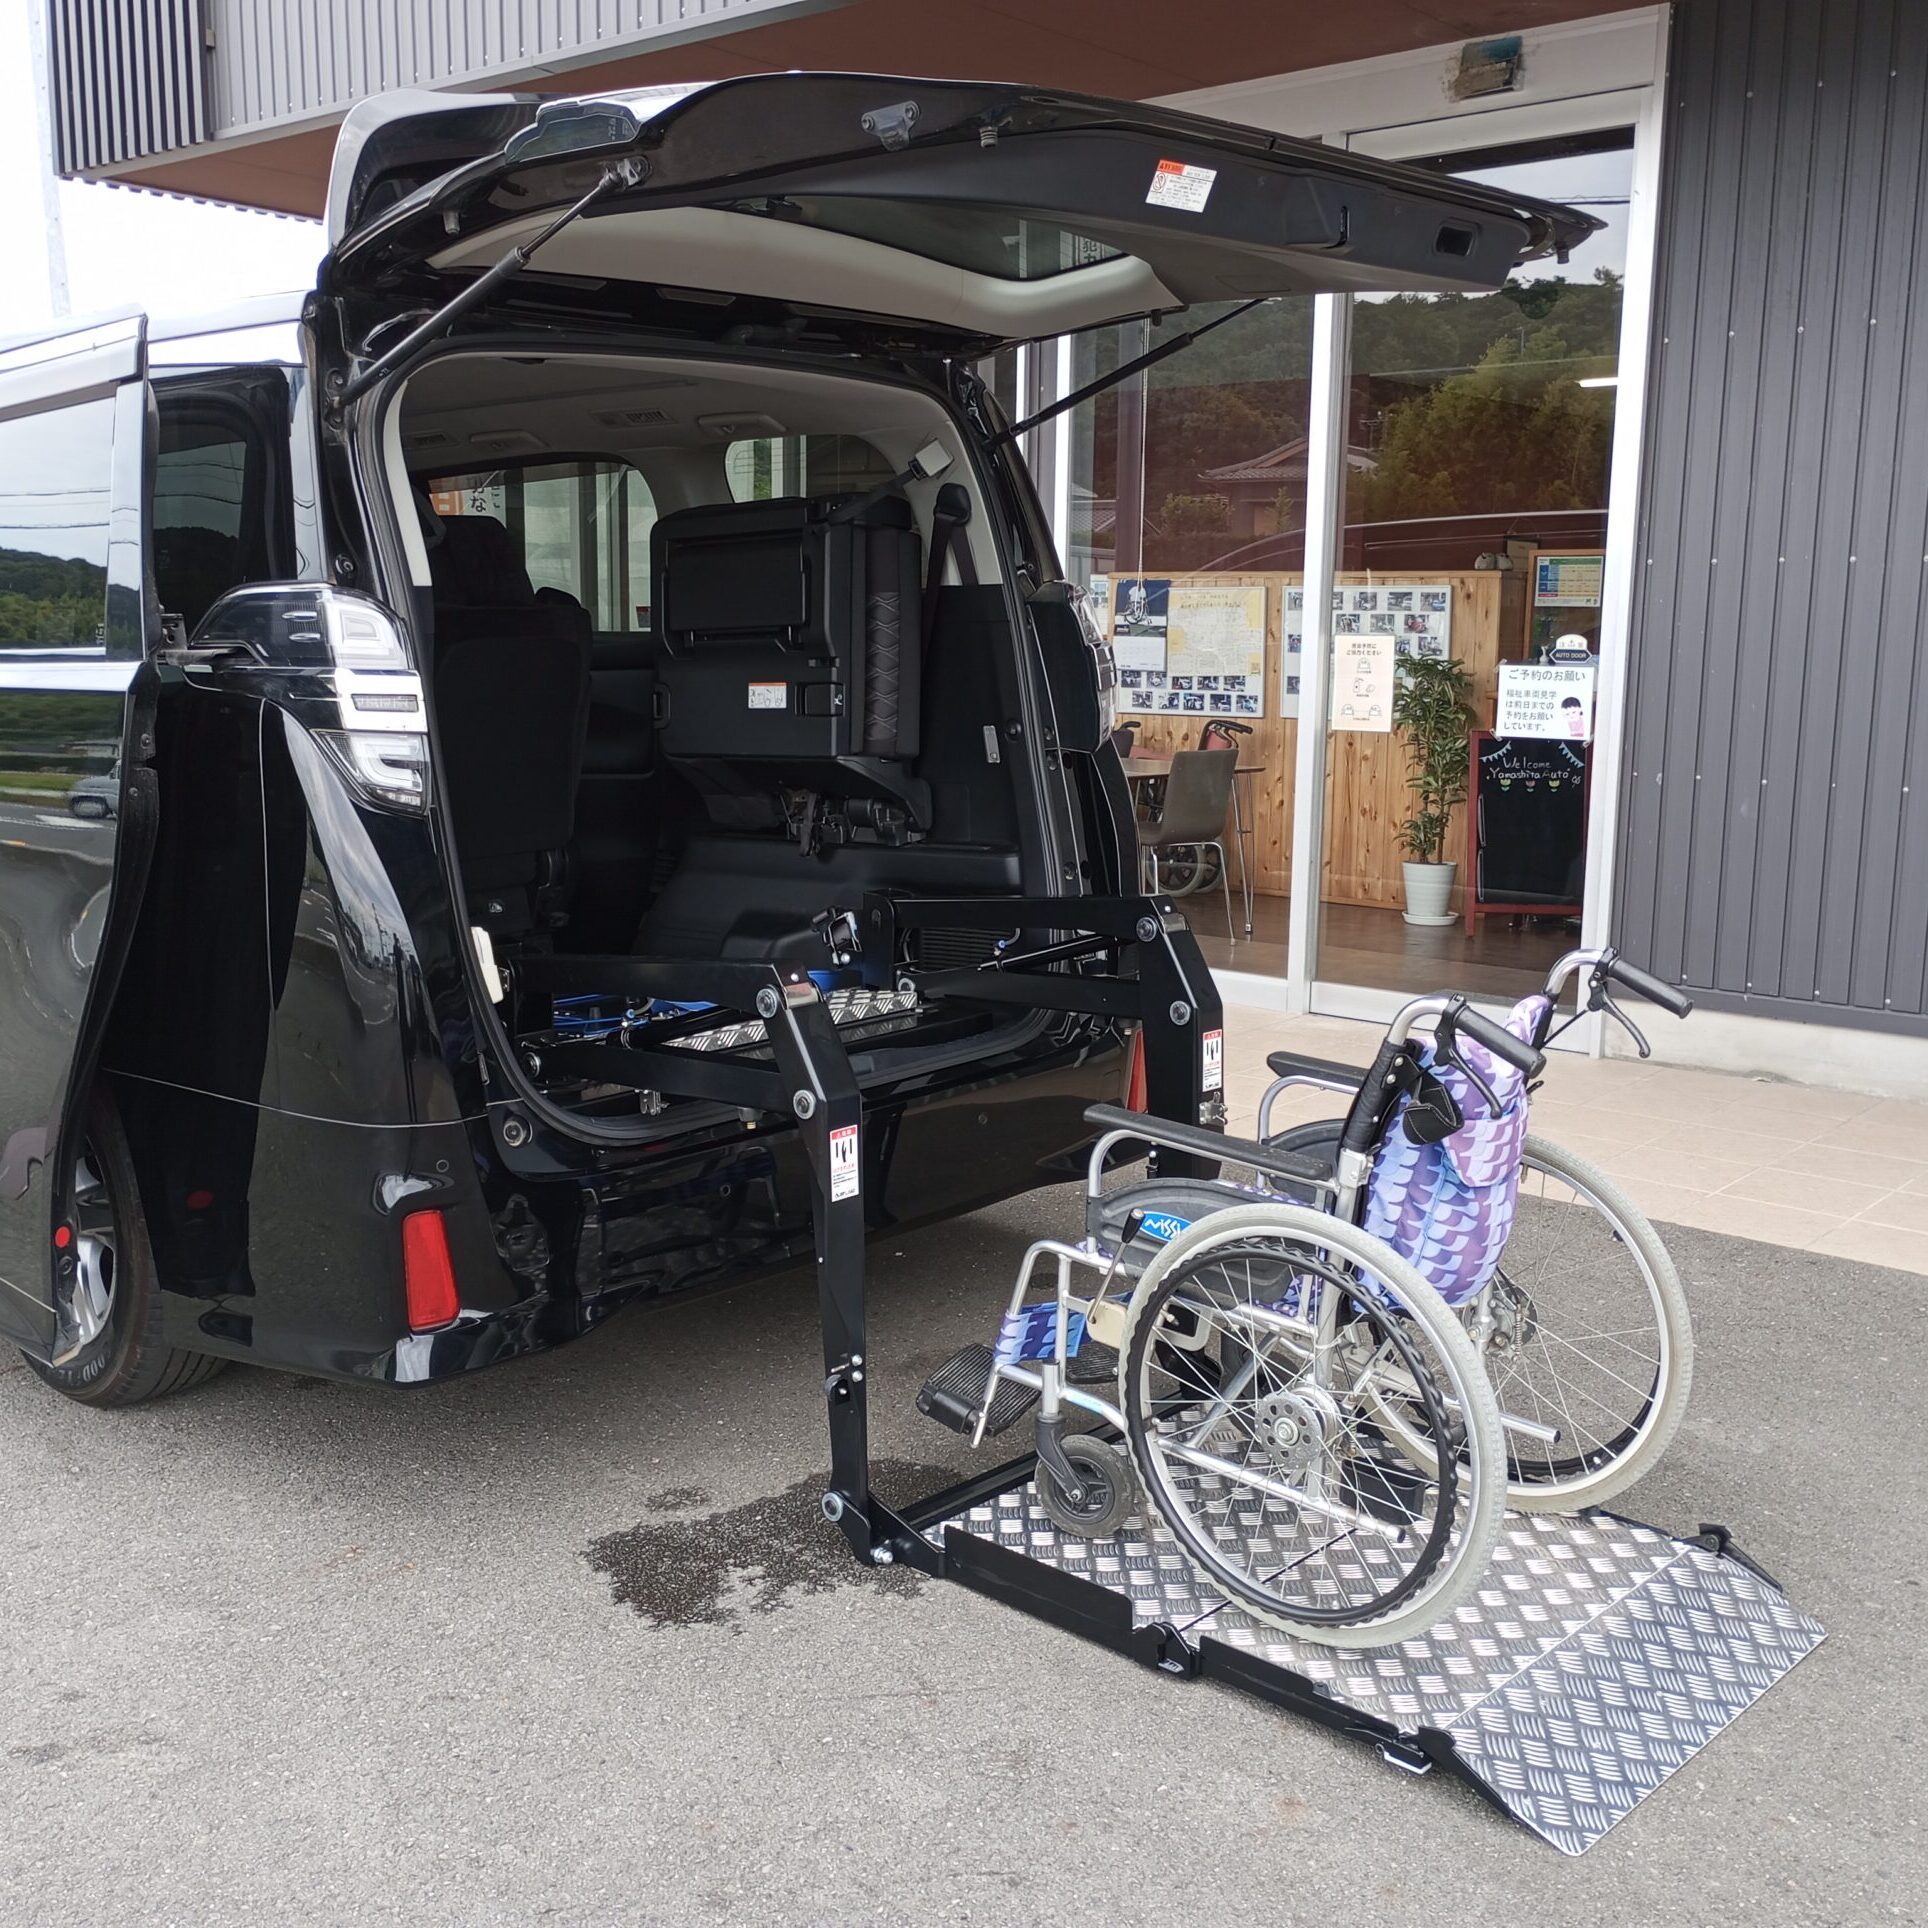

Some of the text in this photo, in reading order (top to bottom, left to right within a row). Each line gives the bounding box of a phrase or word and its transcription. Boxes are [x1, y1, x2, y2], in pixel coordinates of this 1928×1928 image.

[1508, 669, 1586, 682] ご予約のお願い
[1506, 689, 1557, 699] 福祉車両見学
[1505, 700, 1555, 710] は前日までの
[1506, 711, 1554, 720] 予約をお願い
[1503, 722, 1546, 732] しています。
[1502, 756, 1552, 769] Welcome
